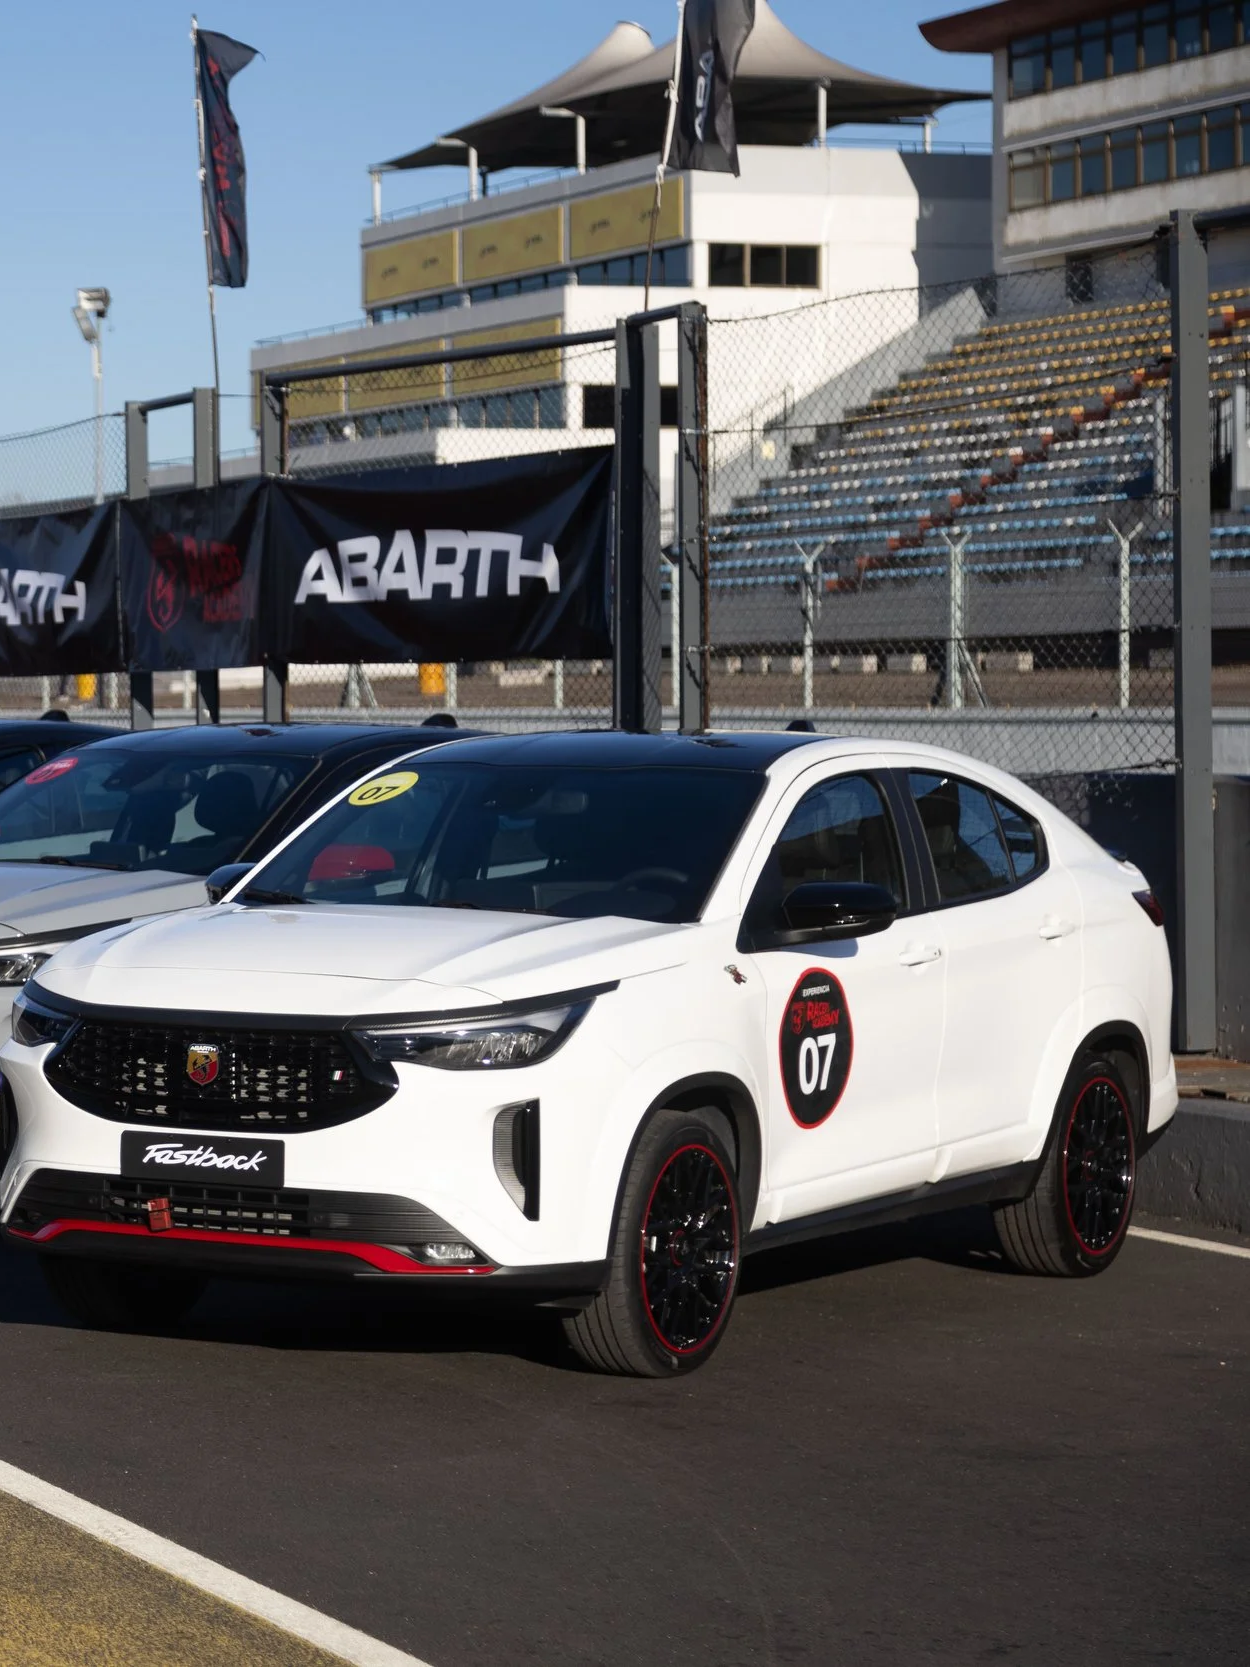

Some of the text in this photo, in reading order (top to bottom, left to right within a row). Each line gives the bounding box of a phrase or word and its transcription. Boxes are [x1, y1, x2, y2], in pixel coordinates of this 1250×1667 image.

[294, 529, 560, 604] ABARTH
[357, 786, 400, 801] 07
[799, 1033, 836, 1095] 07
[142, 1143, 268, 1172] Fastback
